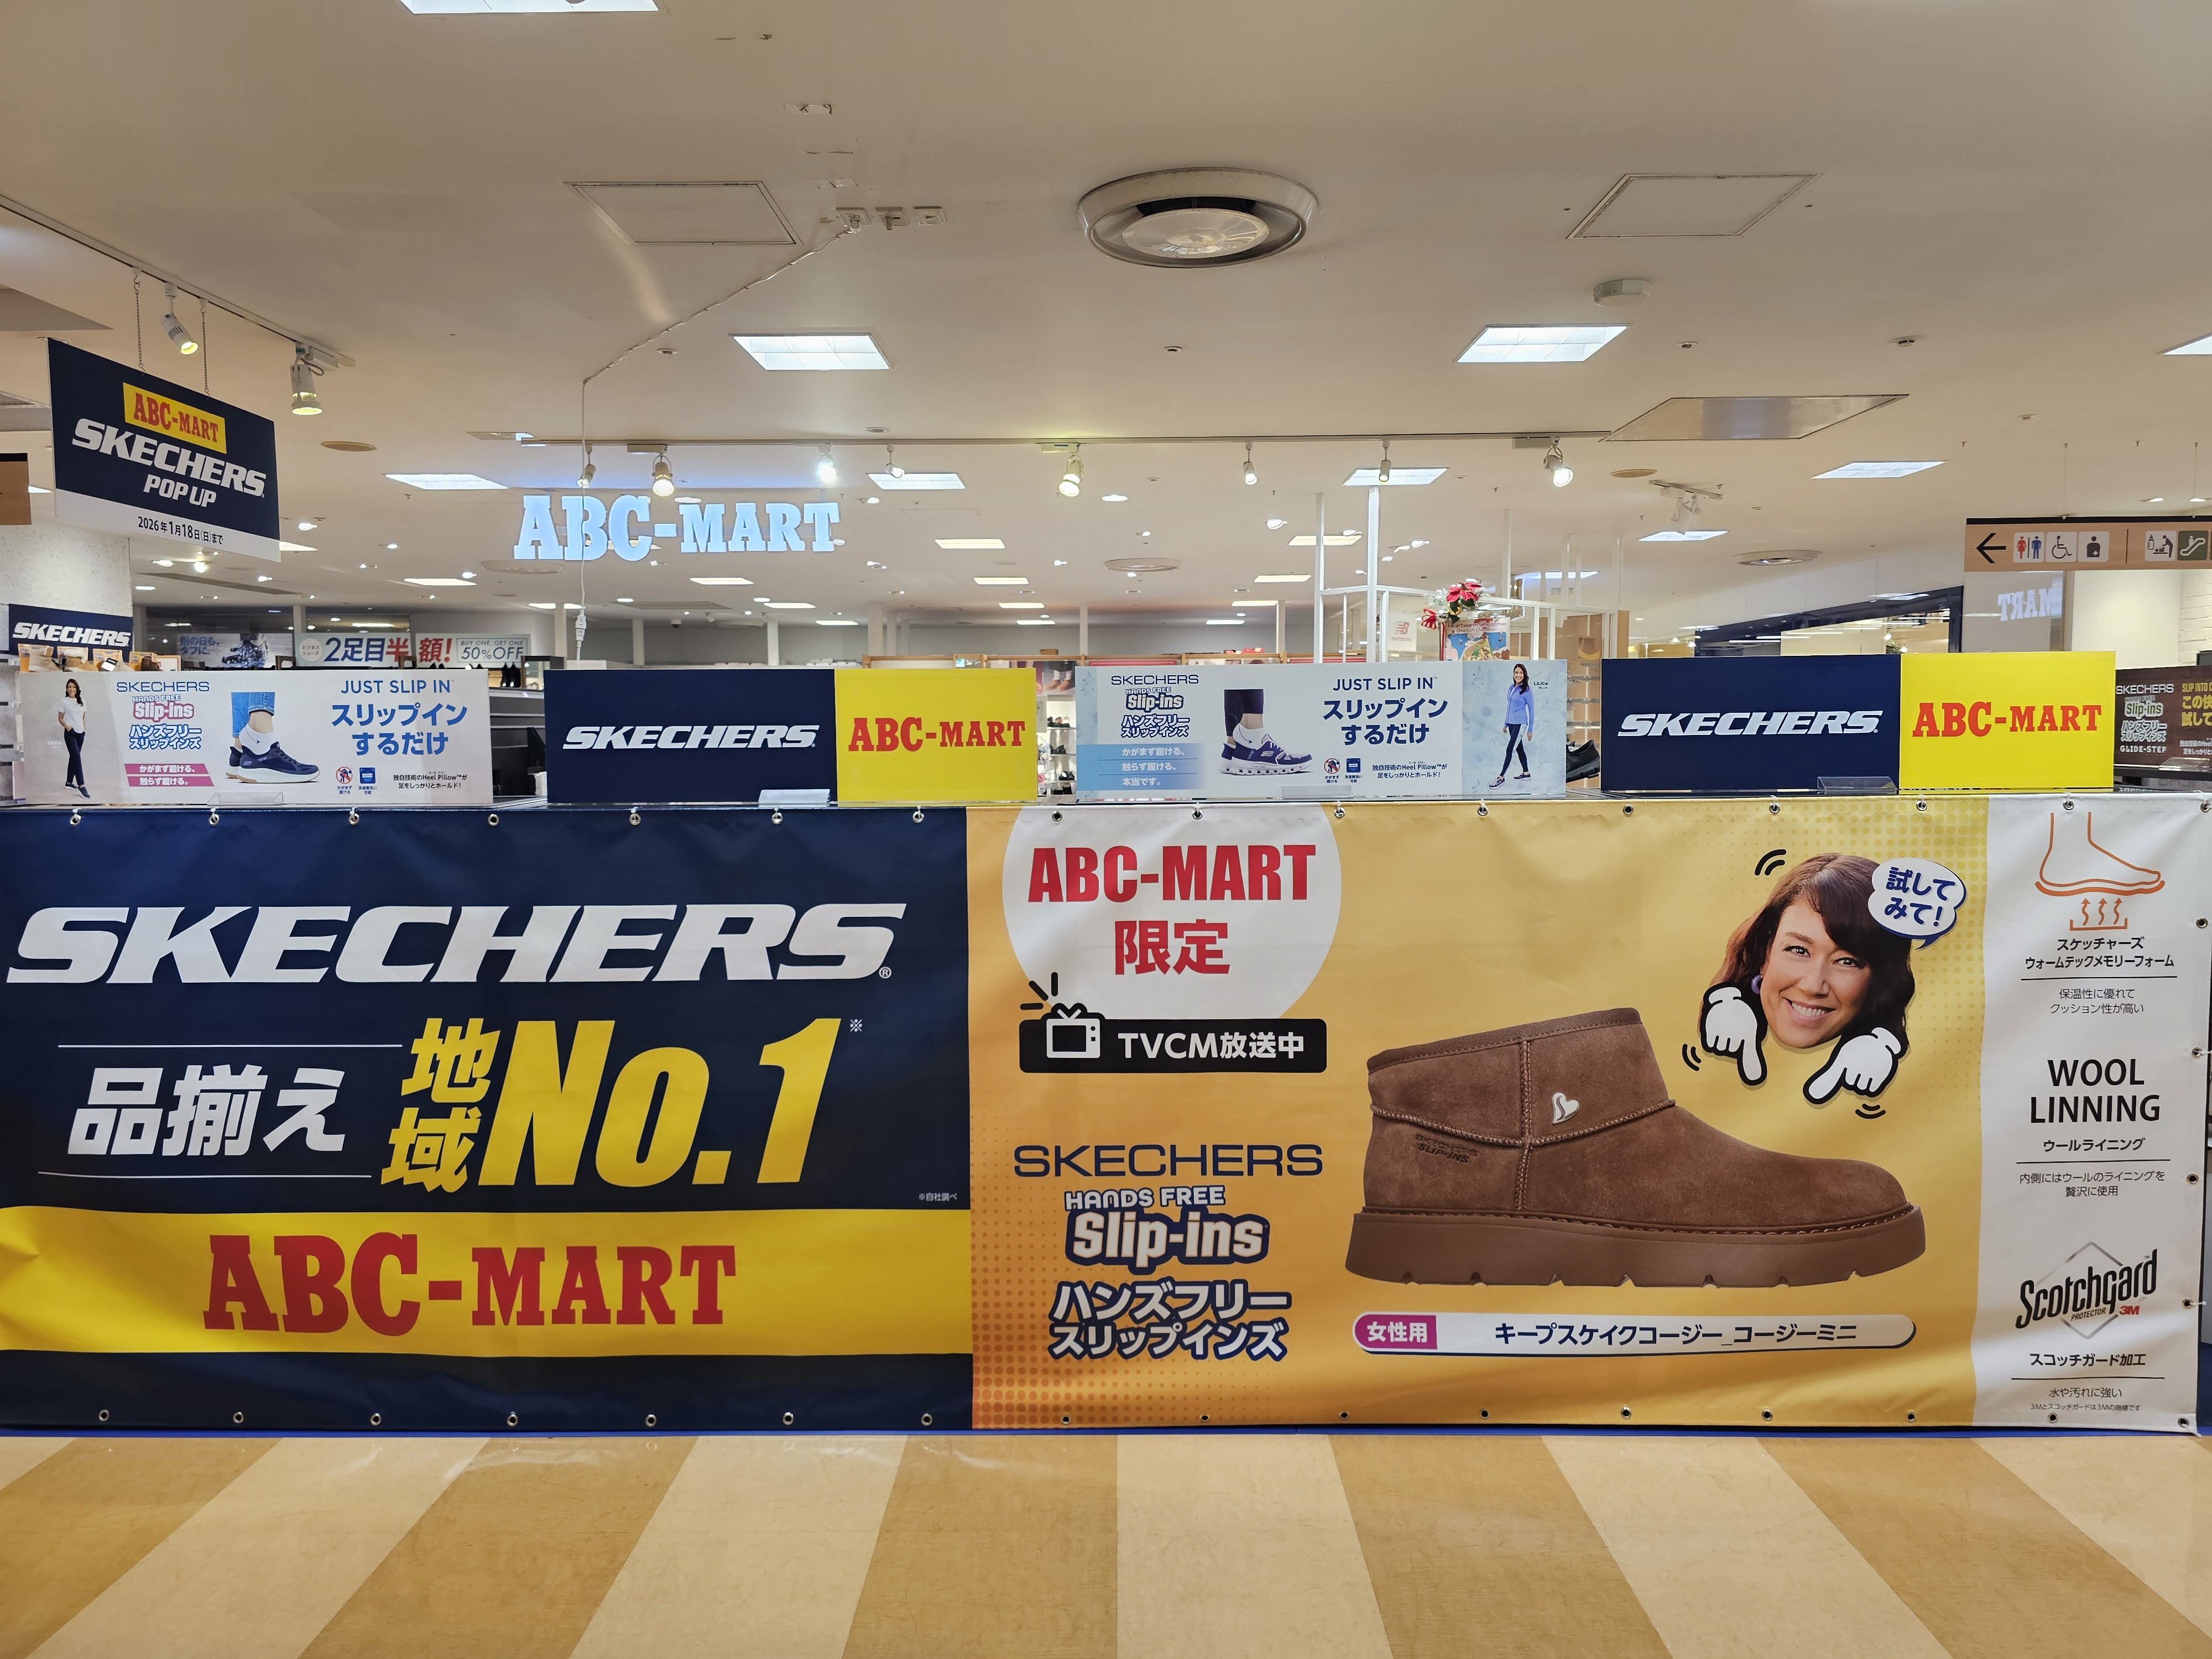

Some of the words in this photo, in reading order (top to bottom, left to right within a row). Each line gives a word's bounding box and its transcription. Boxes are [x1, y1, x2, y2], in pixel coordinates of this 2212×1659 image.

[133, 392, 218, 442] ABC-MART
[72, 418, 267, 498] SKECHERS
[143, 474, 188, 500] POP
[190, 486, 217, 508] UP
[138, 517, 223, 545] 2026年1月18日(日)まで
[514, 495, 840, 561] ABC-MART
[12, 622, 131, 646] SKECHERS
[461, 646, 524, 660] 50%OFF
[117, 682, 210, 692] SKECHERS
[341, 680, 383, 694] JUST
[390, 680, 426, 693] SLIP
[434, 680, 451, 693] IN
[1112, 675, 1199, 685] SKECHERS
[1333, 679, 1372, 691] JUST
[1378, 678, 1412, 690] SLIP
[2116, 684, 2174, 694] SKECHERS
[2182, 683, 2194, 692] SLIP
[2195, 682, 2208, 692] INTO
[134, 702, 194, 722] Slip-ins
[1127, 694, 1183, 712] Slip-ins
[1323, 698, 1448, 720] スリップイン
[2126, 702, 2162, 717] Slip-ins
[332, 702, 468, 727] スリップイン
[1121, 713, 1190, 727] ハンズフリー
[1618, 710, 1883, 737] SKECHERS
[1912, 701, 2101, 737] ABC-MART
[129, 724, 202, 738] ハンズフリー
[848, 717, 1025, 752] ABC-MART
[1121, 725, 1189, 738] スリップインズ
[1342, 723, 1430, 746] するだけ
[2121, 719, 2167, 731] ハンズフリー
[129, 737, 201, 749] スリップインズ
[352, 732, 449, 756] するだけ
[562, 724, 820, 750] SKECHERS
[2121, 731, 2166, 742] スリップインズ
[1122, 748, 1185, 756] かがまず履ける、
[1122, 762, 1176, 771] 触らず履ける、
[1122, 778, 1161, 786] 本当です。
[1027, 844, 1316, 902] ABC-MART
[1885, 866, 1956, 901] 試して
[1884, 896, 1942, 927] みて!
[1114, 919, 1230, 975] 限定
[2057, 936, 2145, 951] スケッチャーズ
[2025, 954, 2174, 970] ウォームテックメモリーフォーム
[2059, 988, 2136, 1000] 保温性に優れて
[2051, 1002, 2144, 1015] クッション性が高い
[1118, 1032, 1304, 1059] TVCM放送中
[2047, 1058, 2144, 1087] WOOL
[67, 1064, 346, 1156] 品揃え
[381, 1018, 500, 1193] 地域
[478, 1018, 842, 1188] No.1
[2031, 1094, 2160, 1124] LINNING
[2043, 1136, 2146, 1152] ウールライニング
[1014, 1144, 1323, 1177] SKECHERS
[2020, 1171, 2165, 1185] 内側にはウールのライニングを
[1066, 1189, 1152, 1209] HANDS
[1161, 1186, 1225, 1206] FREE
[2065, 1186, 2118, 1197] 贅沢に使用
[1073, 1211, 1264, 1267] Slip-ins
[204, 1232, 737, 1337] ABC-MART
[1052, 1280, 1287, 1321] ハンズフリー
[2119, 1306, 2140, 1315] 3M
[2071, 1307, 2106, 1321] PROTECTOR
[1051, 1321, 1285, 1357] スリップインズ
[1367, 1321, 1428, 1343] 女性用
[2029, 1353, 2146, 1366] スコッチガード加工
[2048, 1387, 2122, 1398] 水や汚れに強い
